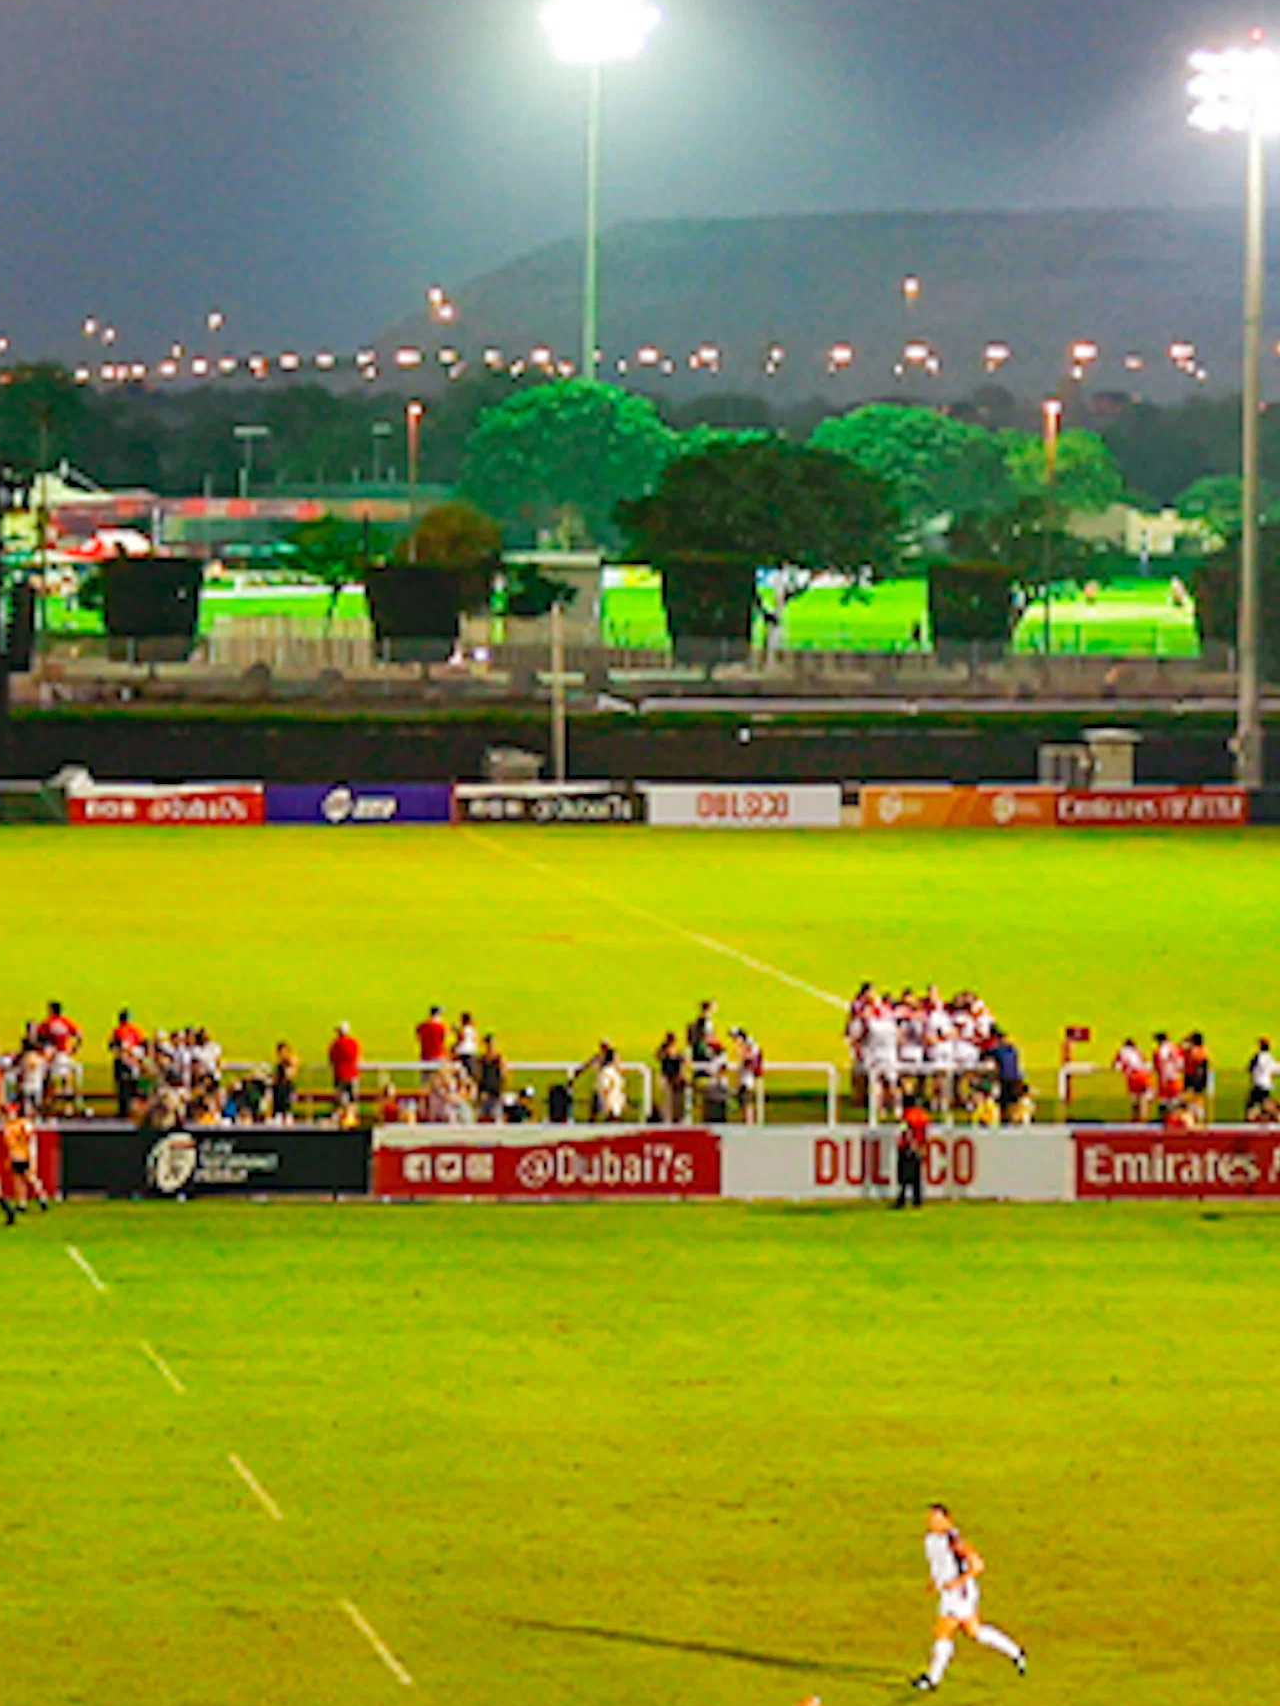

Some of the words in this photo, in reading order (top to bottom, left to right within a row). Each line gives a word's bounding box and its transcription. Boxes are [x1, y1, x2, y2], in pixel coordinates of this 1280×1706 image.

[516, 1143, 695, 1189] @Dubai7s
[814, 1137, 978, 1186] DULCO
[1083, 1143, 1262, 1186] Emirates
